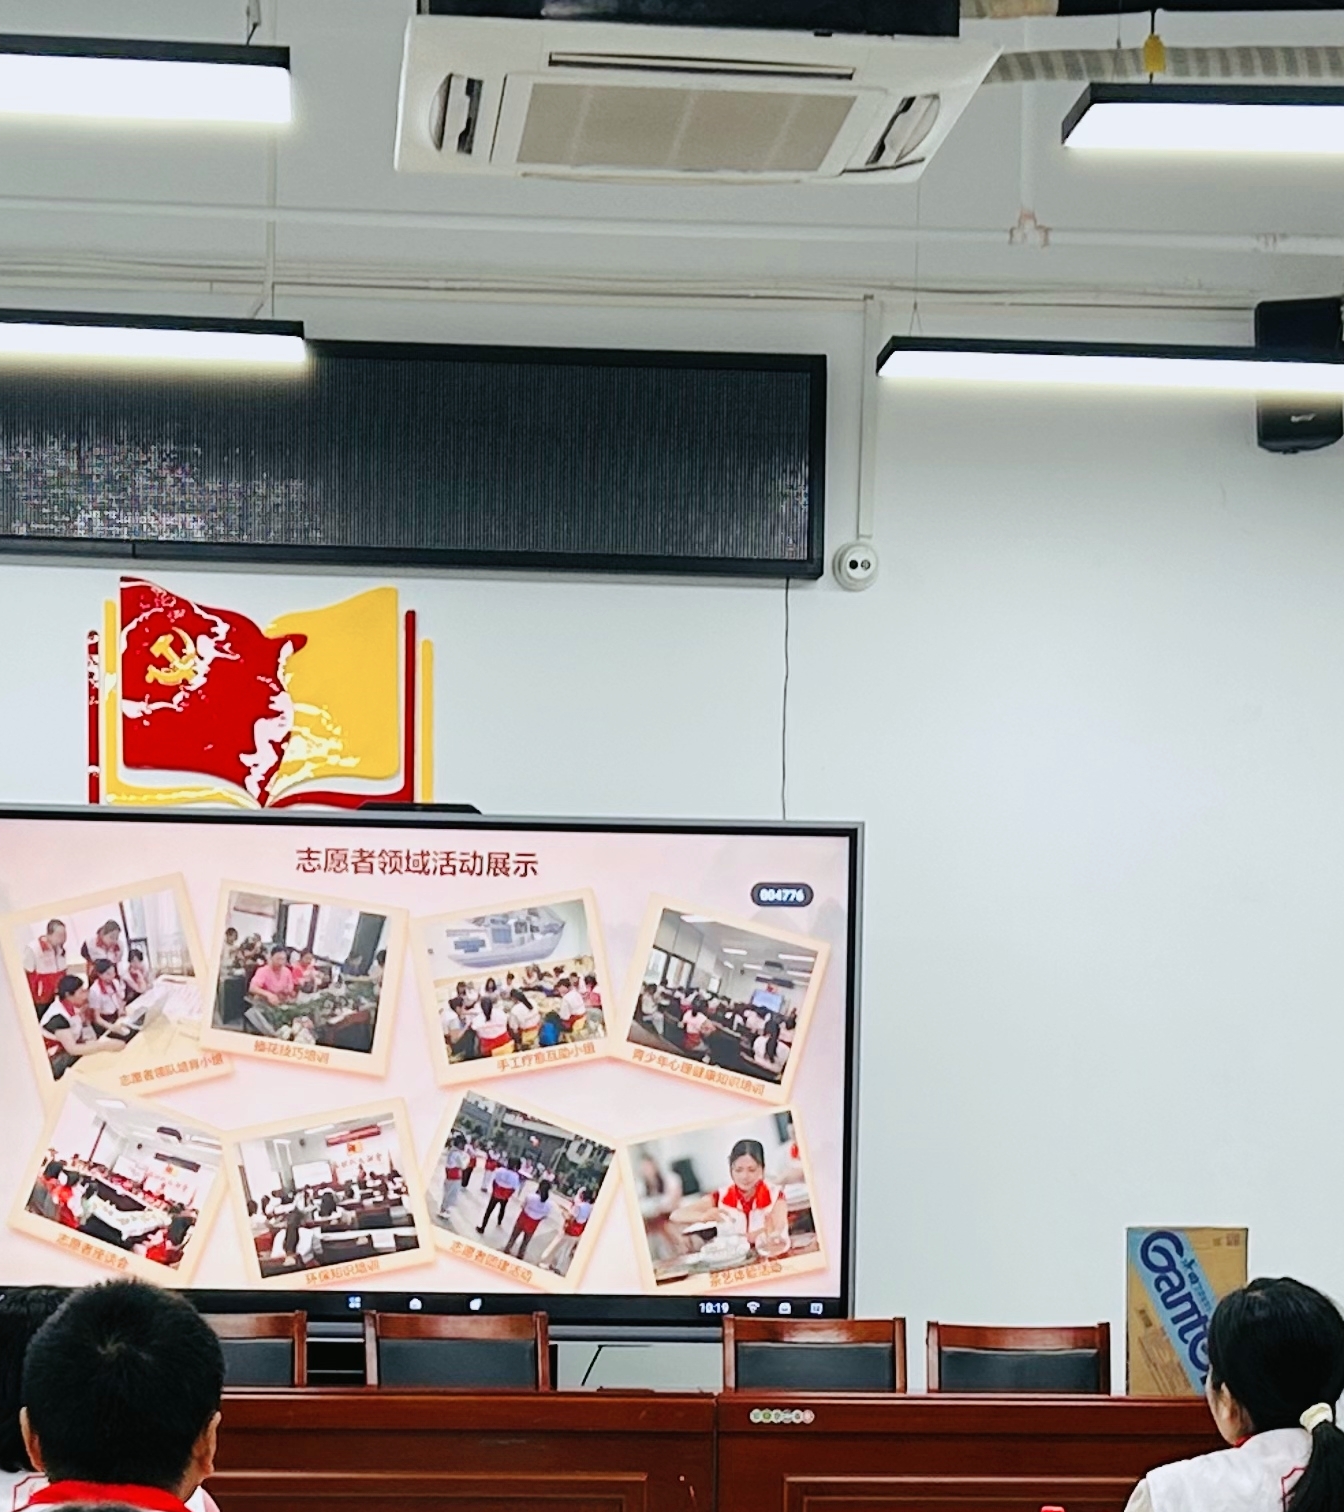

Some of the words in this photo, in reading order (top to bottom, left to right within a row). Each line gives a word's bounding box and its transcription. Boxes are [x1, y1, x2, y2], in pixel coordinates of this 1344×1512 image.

[295, 846, 539, 878] 志愿者领域活动展示
